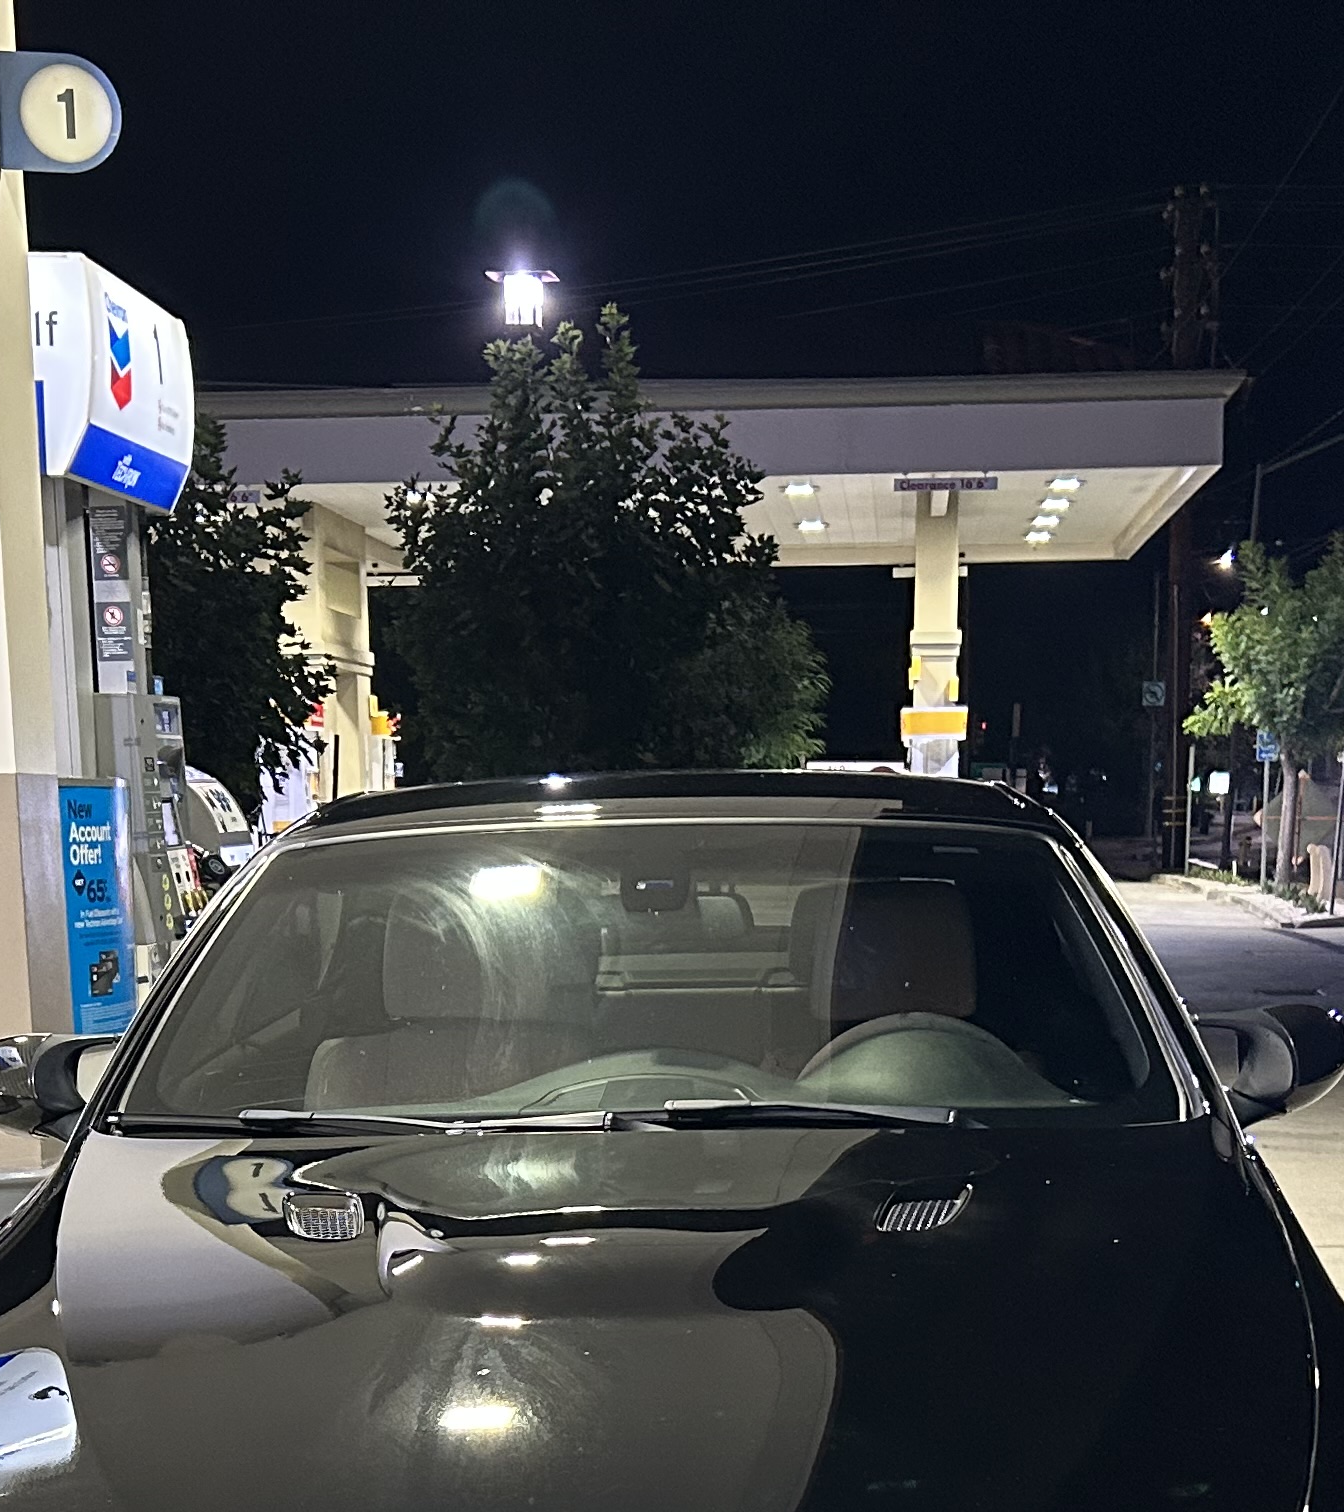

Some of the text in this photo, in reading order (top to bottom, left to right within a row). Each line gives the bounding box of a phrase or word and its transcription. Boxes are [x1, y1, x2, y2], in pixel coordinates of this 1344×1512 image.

[56, 88, 77, 140] 1
[899, 479, 956, 491] Clearance
[67, 799, 93, 820] New
[69, 820, 112, 843] Account
[69, 843, 103, 866] Offer!
